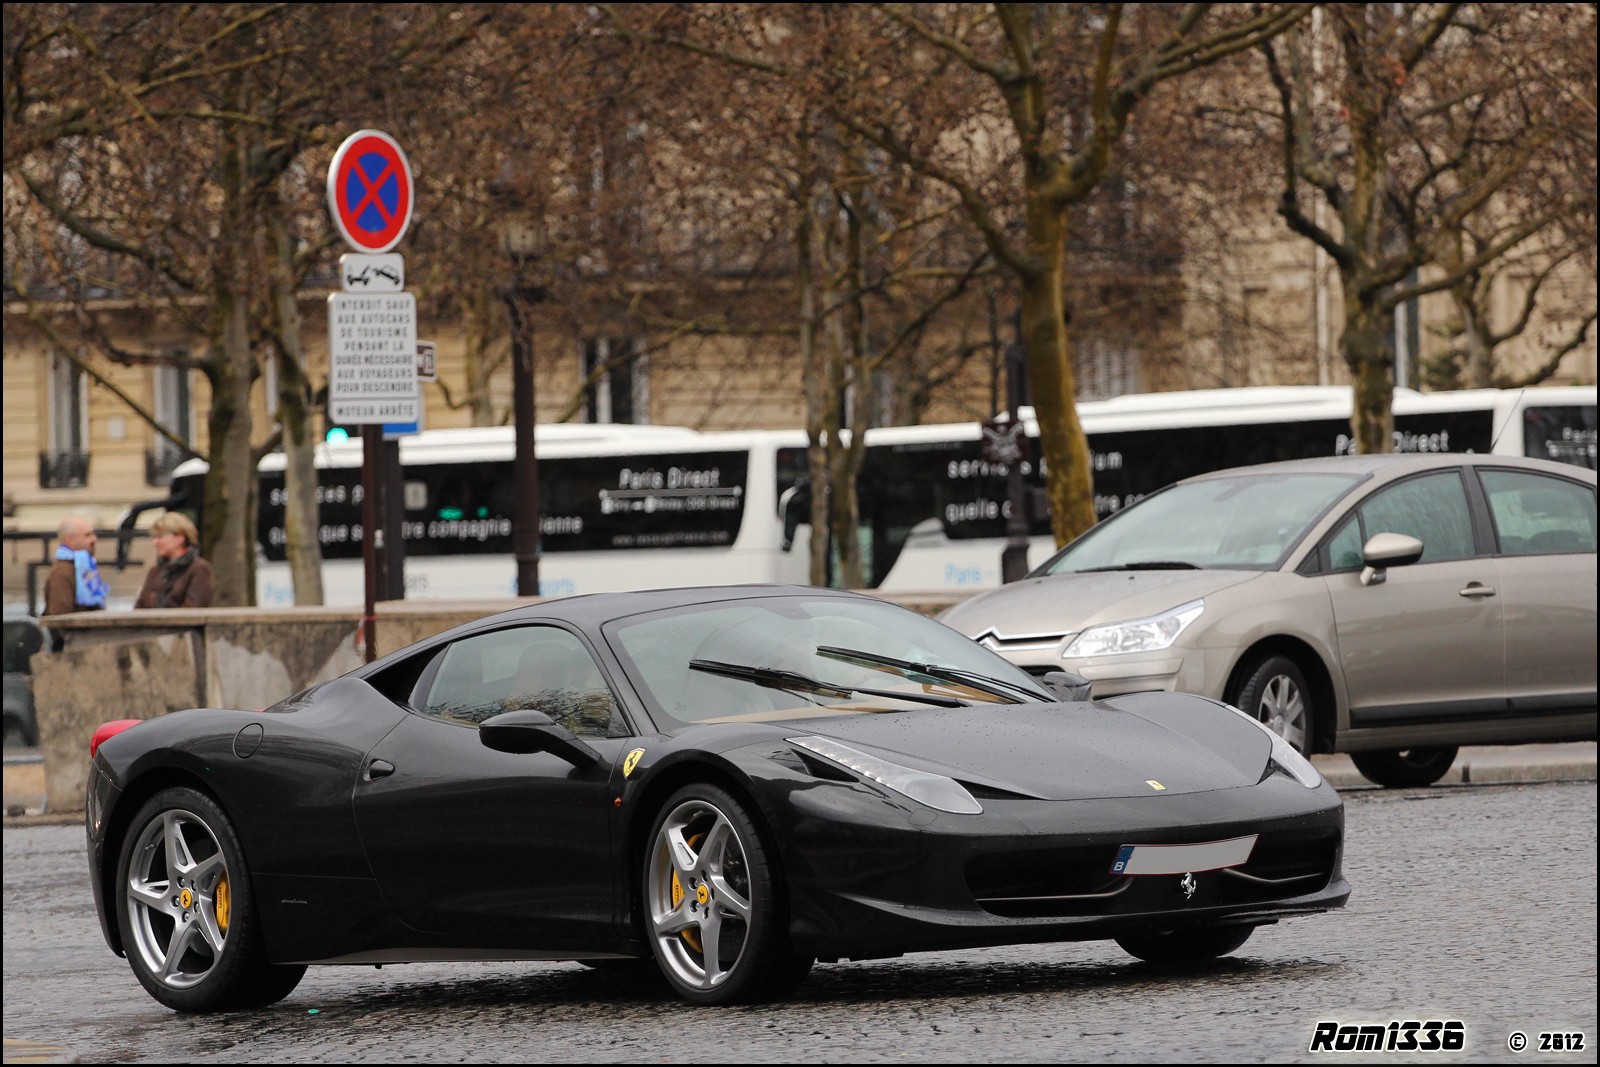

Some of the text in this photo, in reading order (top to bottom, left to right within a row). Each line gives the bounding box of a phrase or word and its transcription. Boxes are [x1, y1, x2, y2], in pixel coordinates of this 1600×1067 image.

[336, 299, 410, 310] INTERDIT SAUF
[338, 312, 410, 324] AUX AUTOCARS
[341, 326, 408, 338] DE TOURISME
[344, 340, 404, 352] PENDANT LA
[337, 367, 413, 379] AUX VOYAGEURS
[336, 381, 413, 393] POUR DESCENDRE
[336, 405, 375, 417] MOTEUR
[619, 467, 720, 489] Paris Direct
[945, 498, 999, 525] quelle
[428, 515, 512, 542] compagnie
[1113, 861, 1125, 872] B
